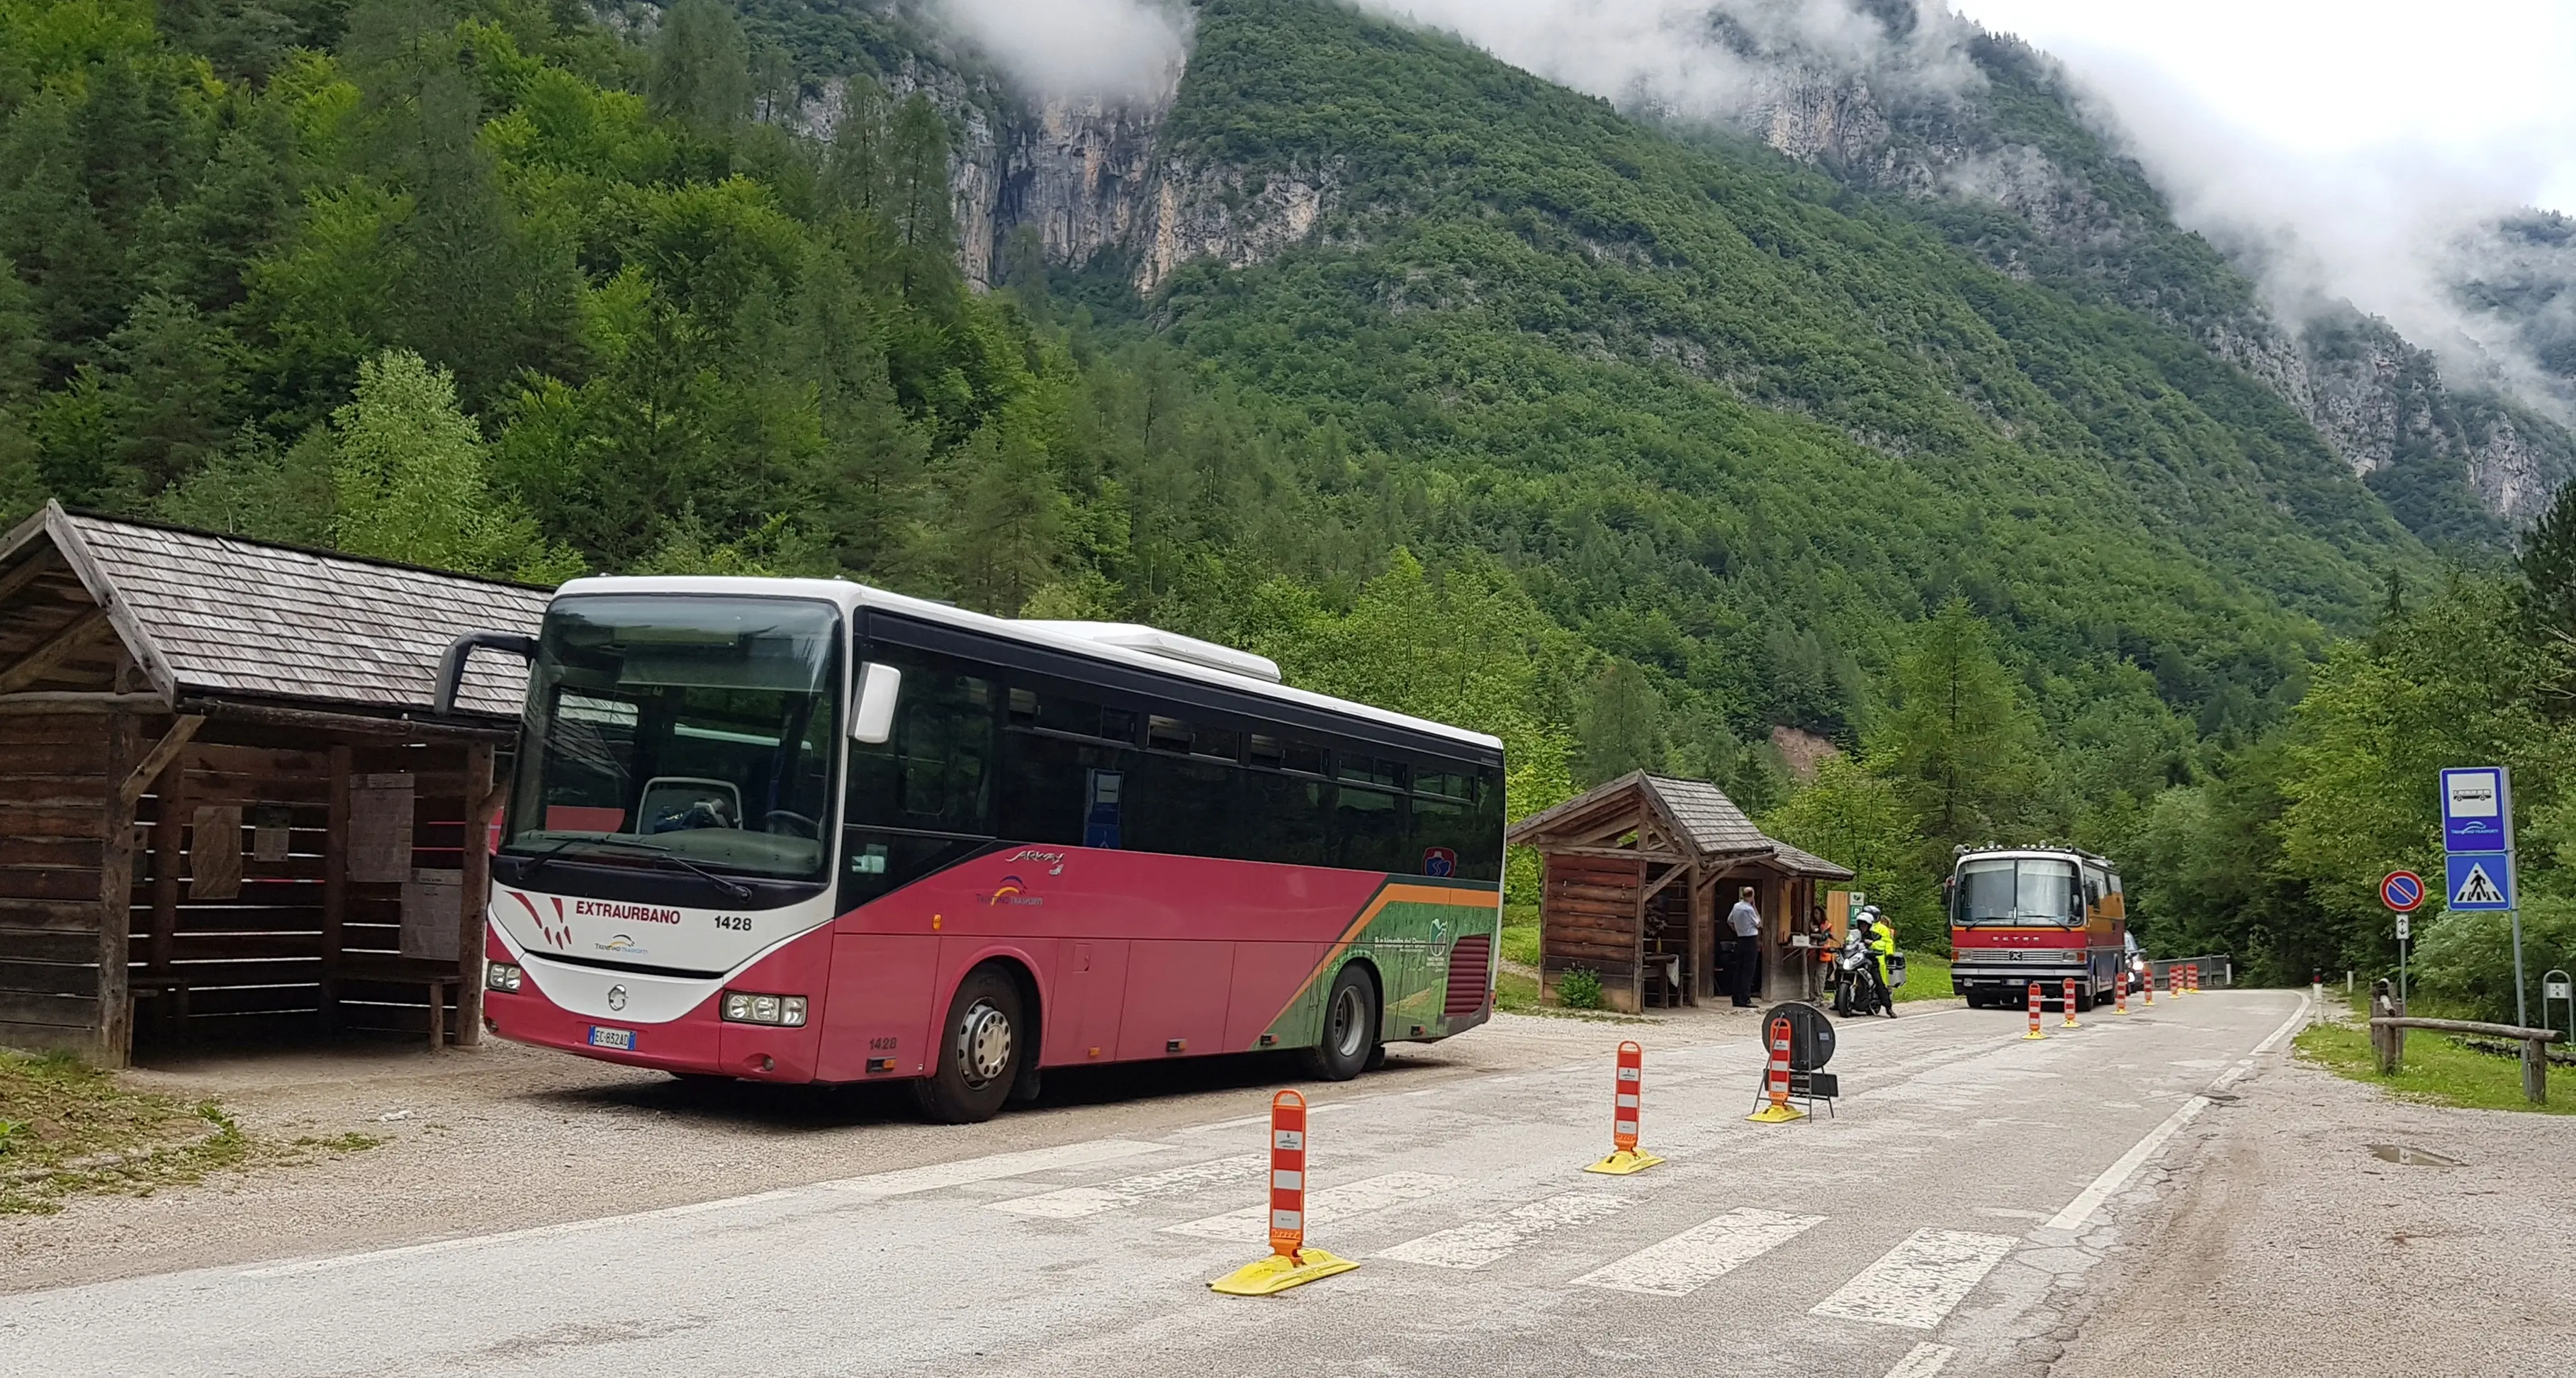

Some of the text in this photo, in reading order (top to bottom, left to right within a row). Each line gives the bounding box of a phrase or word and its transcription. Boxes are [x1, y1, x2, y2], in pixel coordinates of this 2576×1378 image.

[575, 900, 681, 925] EXTRAURBANO
[714, 915, 753, 931] 1428
[869, 1036, 897, 1051] 1428
